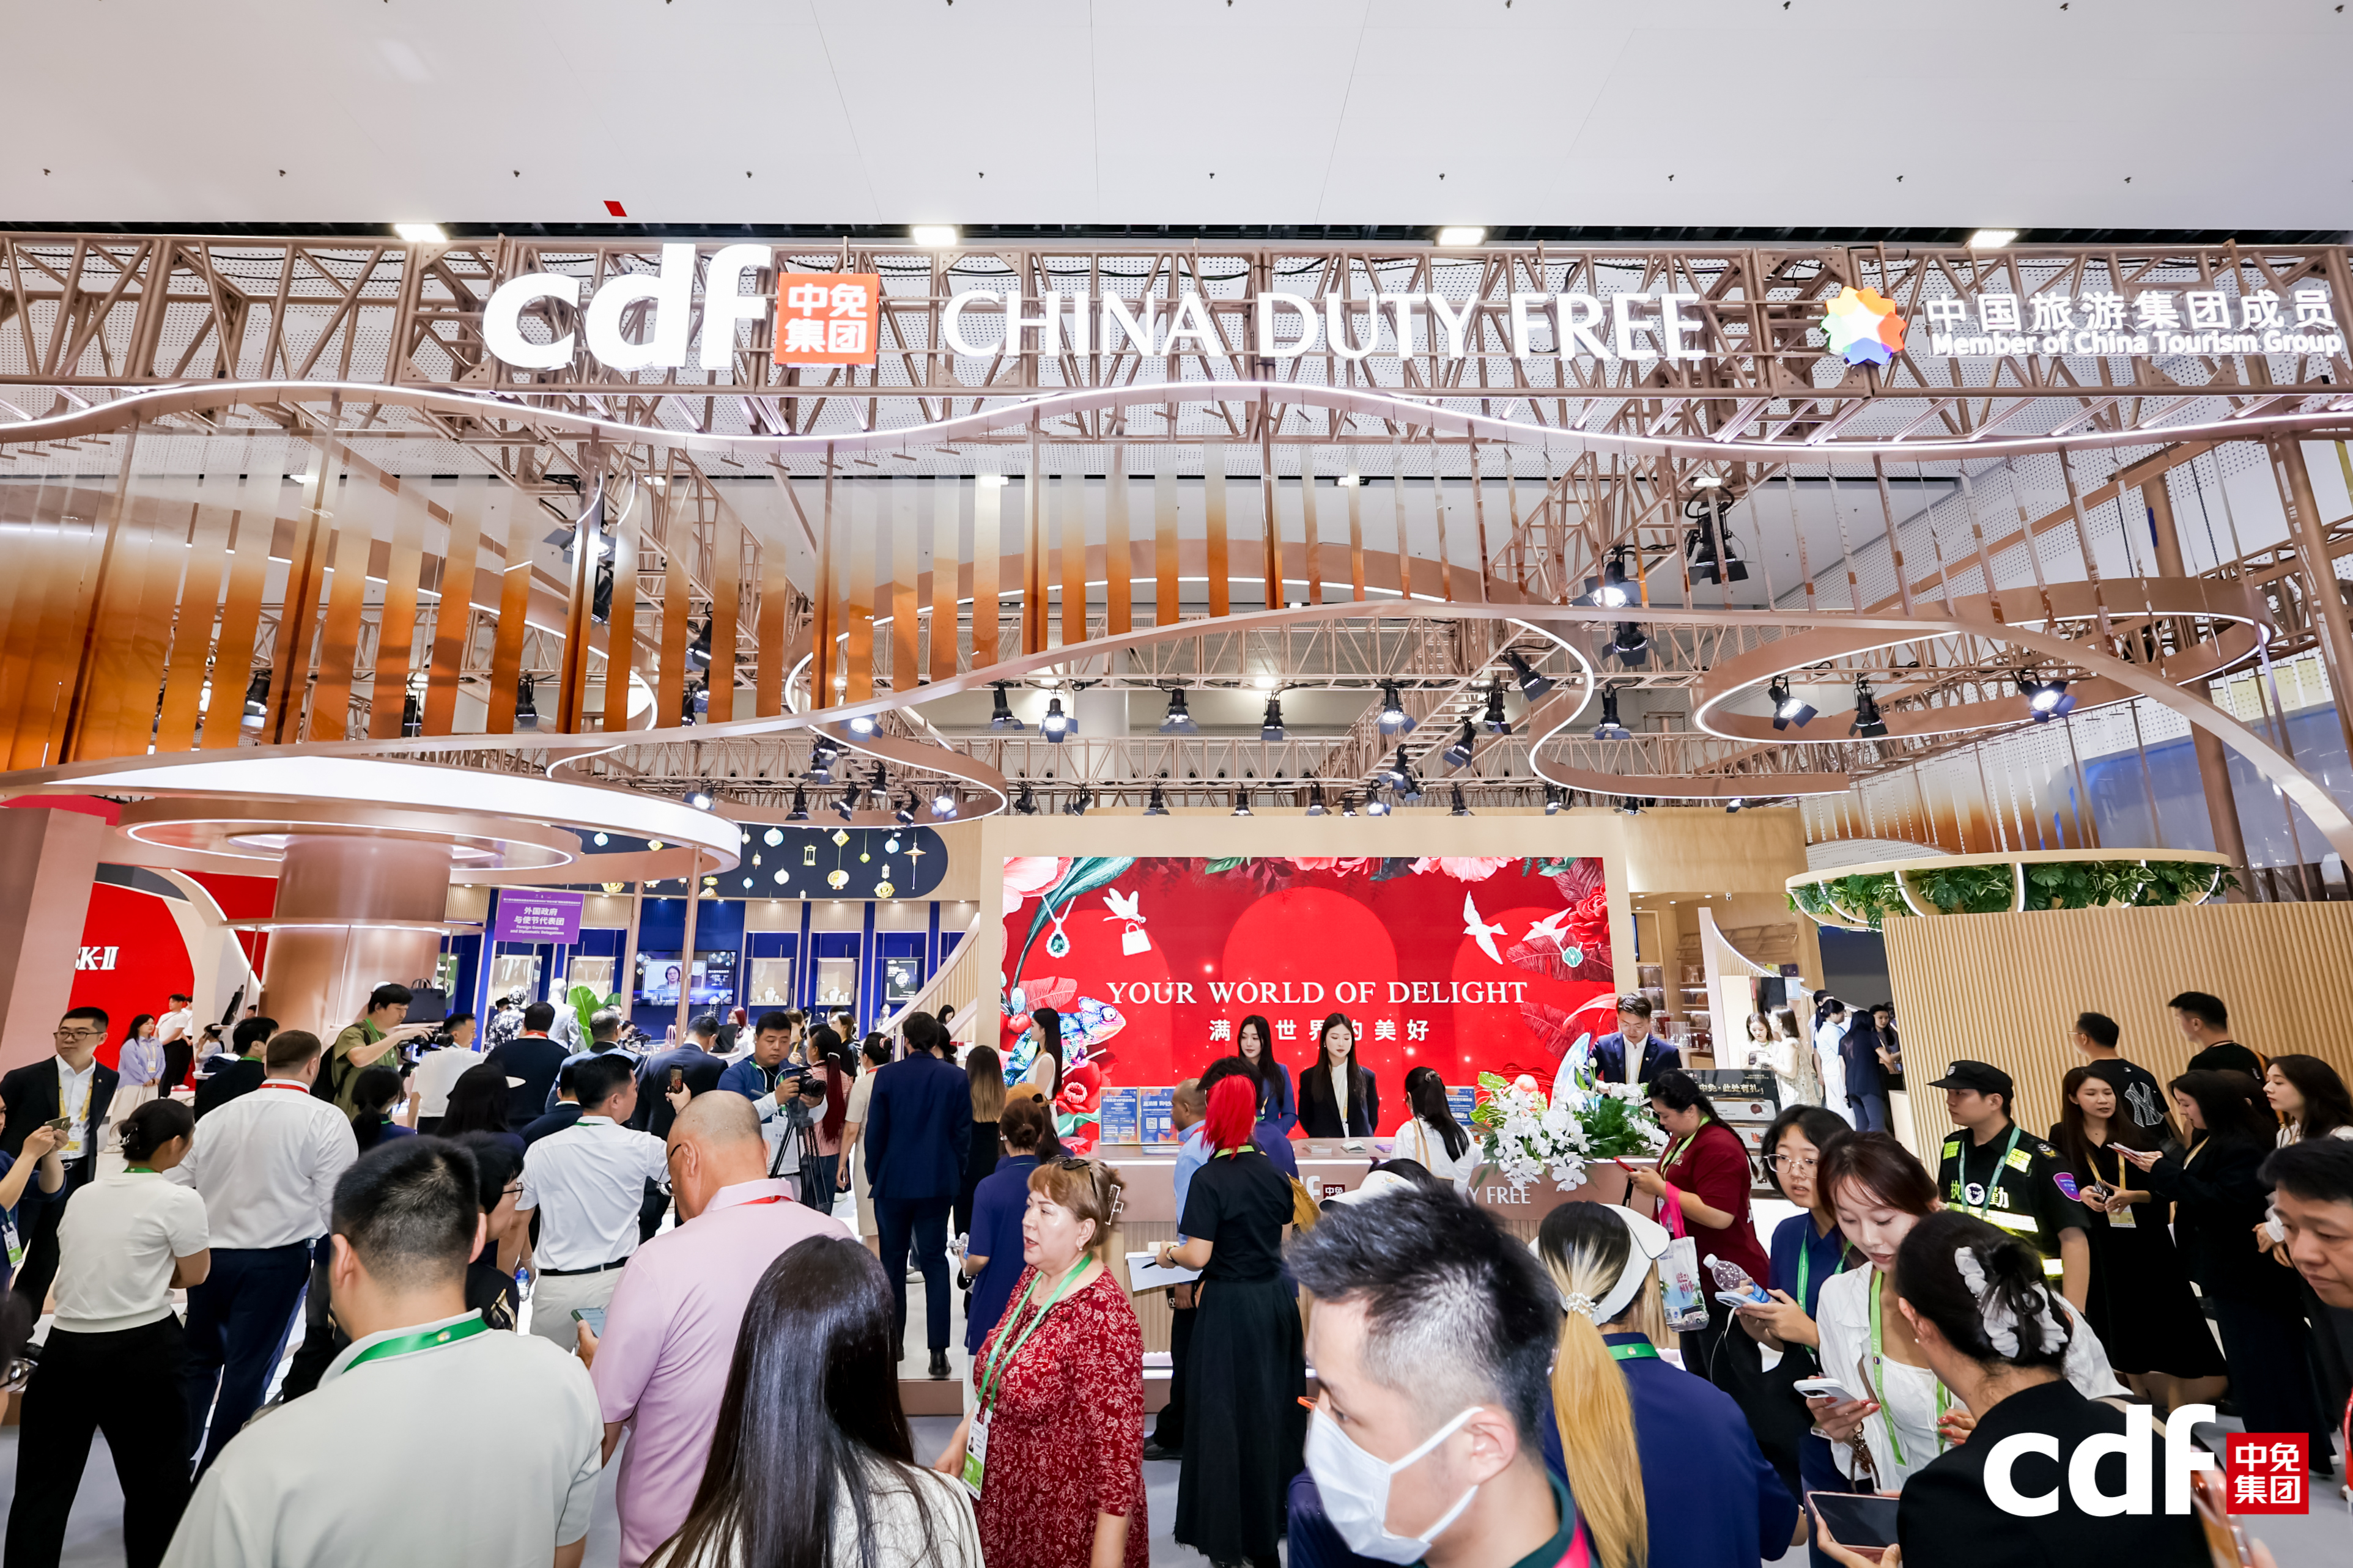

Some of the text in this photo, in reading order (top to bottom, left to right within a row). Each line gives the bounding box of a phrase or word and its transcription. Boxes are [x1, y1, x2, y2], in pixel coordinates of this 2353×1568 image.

[483, 243, 772, 370] cdf
[788, 283, 867, 317] 中免
[1926, 290, 2337, 332] 中国旅游集团成员
[785, 320, 866, 353] 集团
[942, 290, 1706, 361] CHINA DUTY FREE
[1932, 330, 2342, 358] Member of China Tourism Group
[514, 916, 565, 926] 与使节代表团
[523, 907, 558, 916] 外国政府
[1106, 981, 1527, 1004] YOUR WORLD OF DELIGHT
[2124, 1081, 2164, 1128] NY
[1487, 1186, 1531, 1204] FREE
